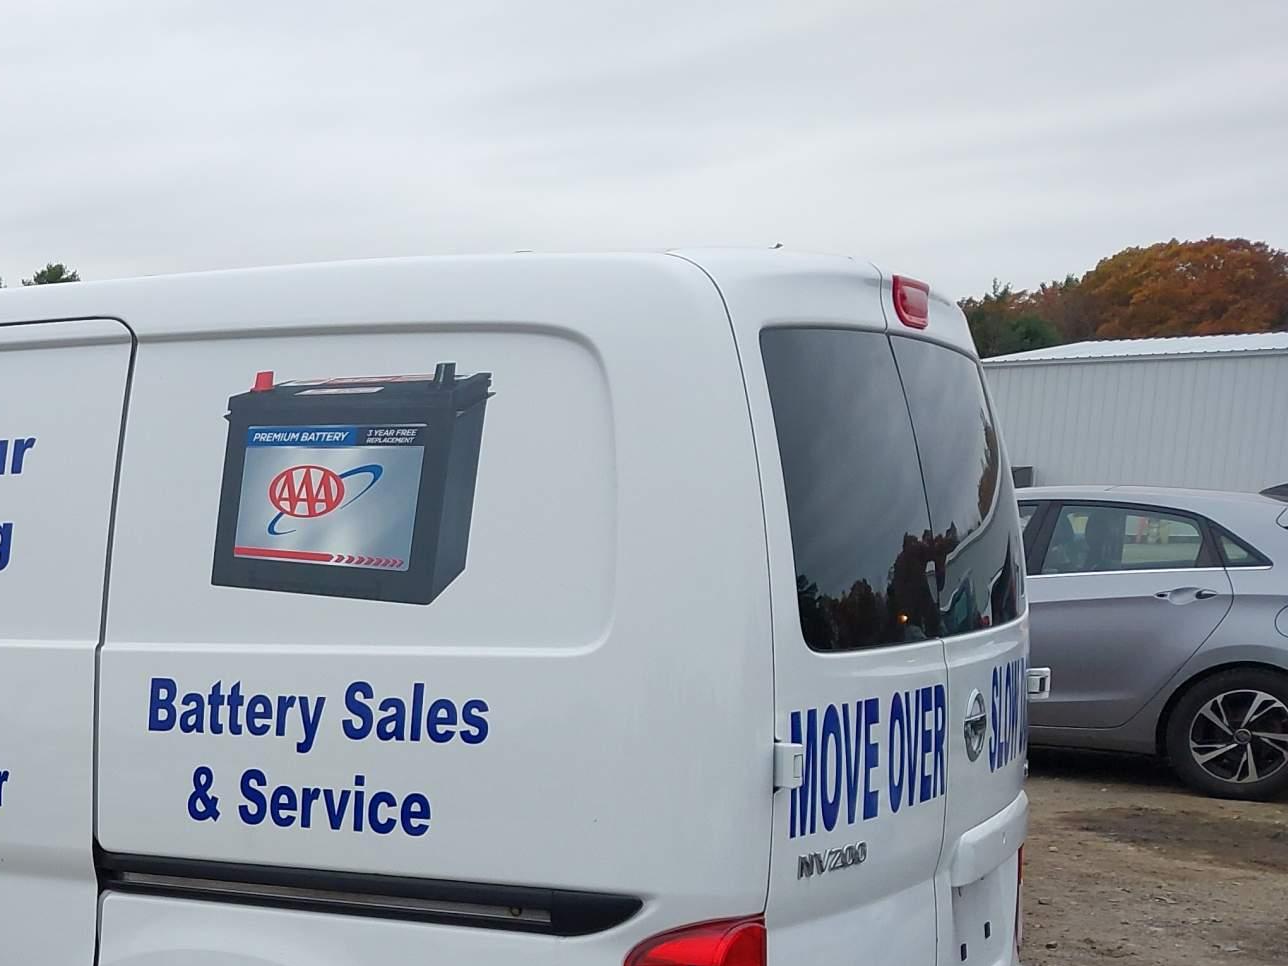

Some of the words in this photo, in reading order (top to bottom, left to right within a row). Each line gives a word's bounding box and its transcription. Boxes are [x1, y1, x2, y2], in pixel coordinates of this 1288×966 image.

[253, 431, 299, 442] PREMIUM
[300, 431, 349, 442] BATTERY
[366, 429, 373, 437] 3
[373, 429, 395, 437] YEAR
[395, 428, 418, 437] FREE
[276, 467, 336, 517] AAA
[148, 677, 326, 753] Battery
[342, 681, 490, 744] Sales
[789, 697, 879, 838] MOVE
[888, 684, 946, 813] OVER
[188, 767, 219, 820] &
[239, 768, 432, 837] Service
[797, 842, 867, 880] NV200
